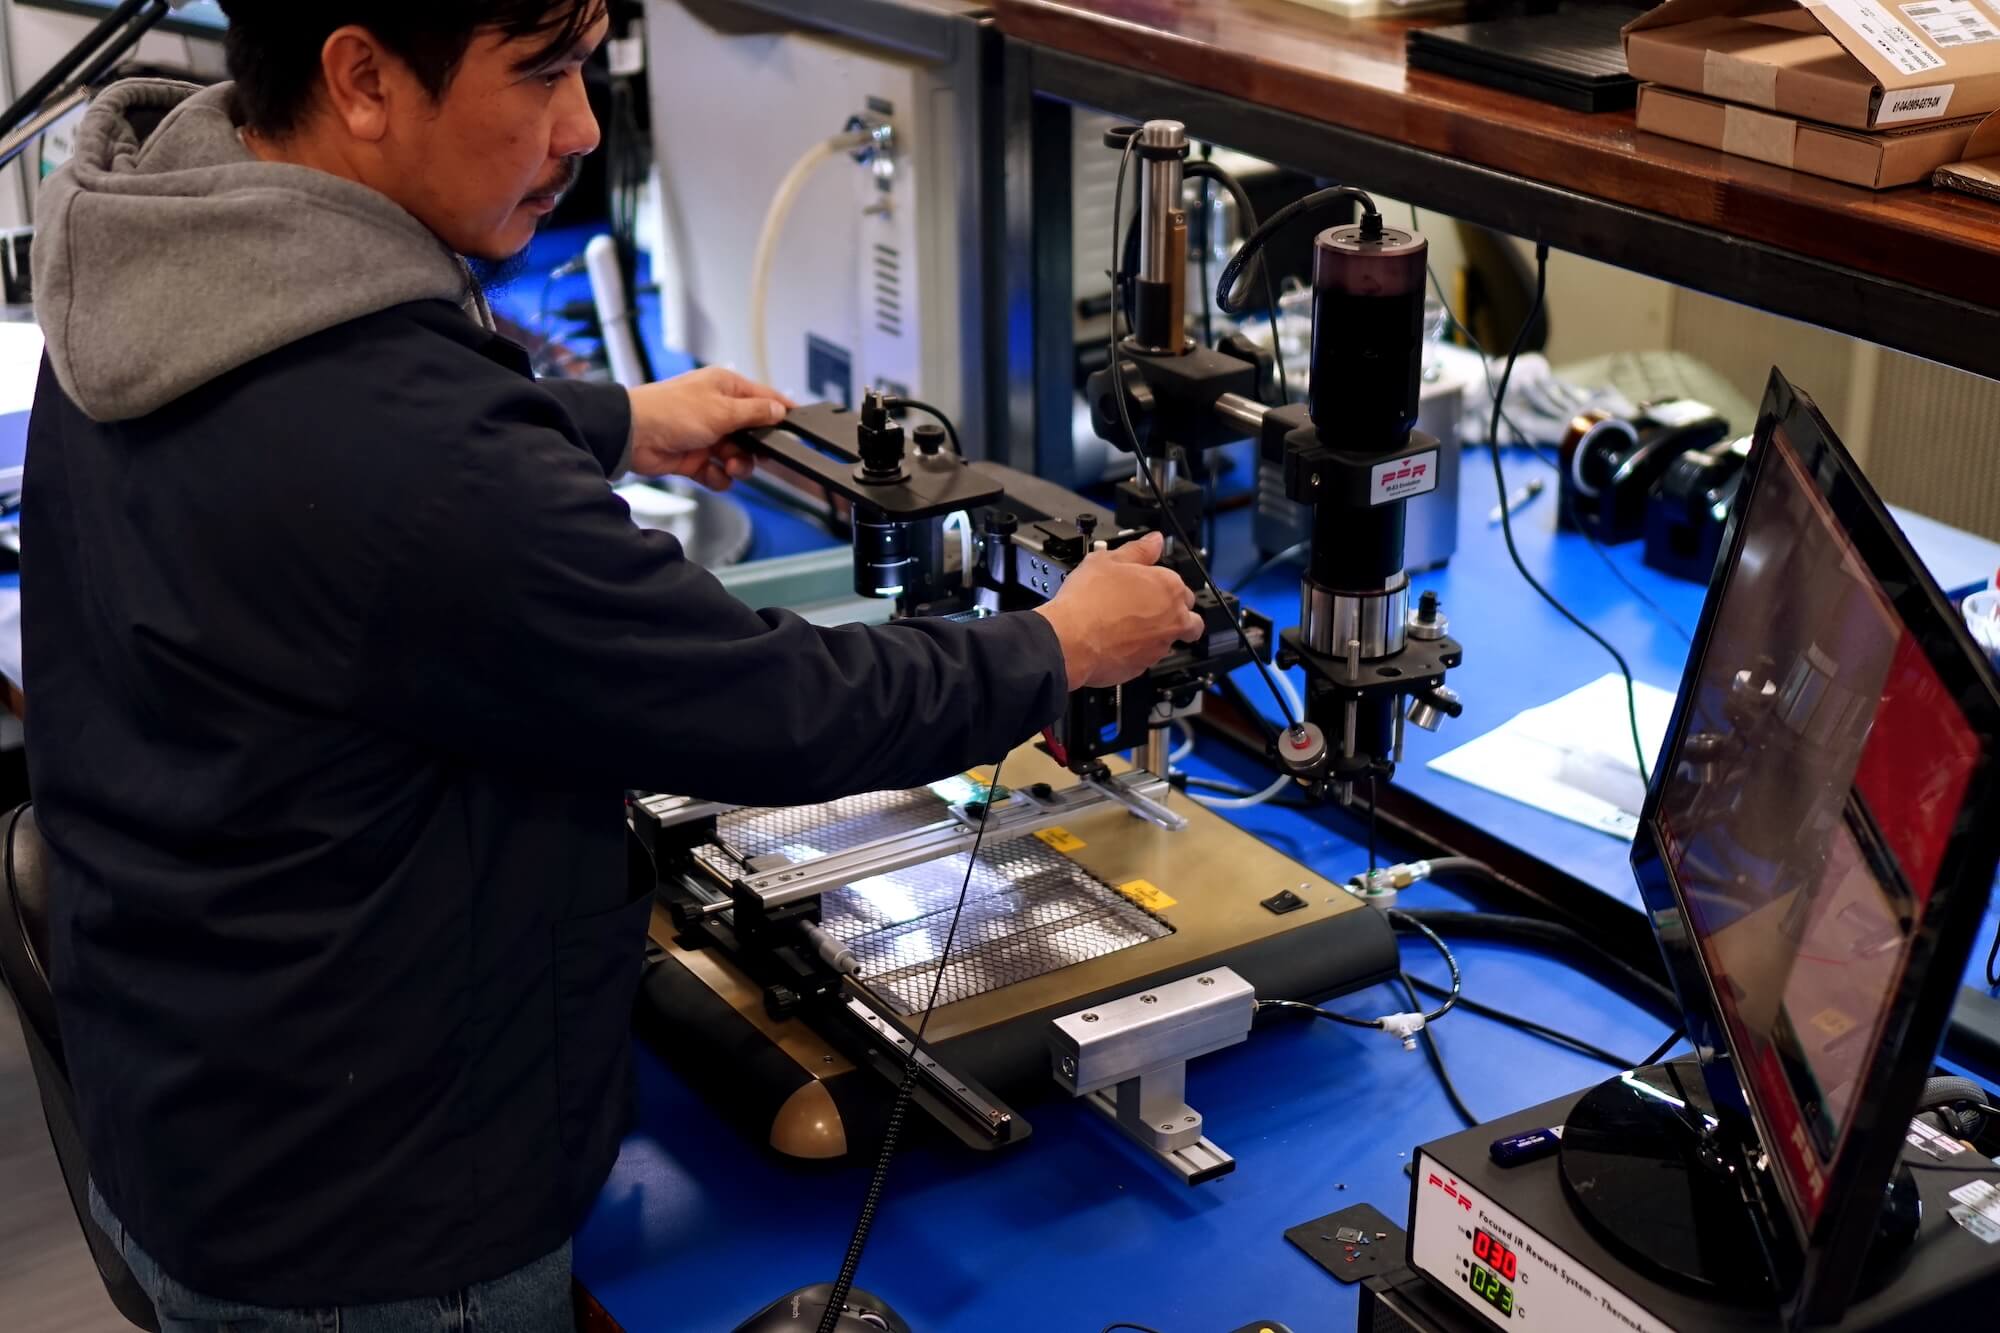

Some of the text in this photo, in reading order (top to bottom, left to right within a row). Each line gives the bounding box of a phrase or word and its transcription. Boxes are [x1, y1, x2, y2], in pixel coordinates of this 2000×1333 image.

[1475, 1231, 1517, 1280] 030
[1479, 1210, 1513, 1241] Focused
[1514, 1235, 1524, 1249] IR
[1526, 1244, 1558, 1275] Rework
[1561, 1269, 1592, 1299] System
[1473, 1266, 1513, 1312] 023
